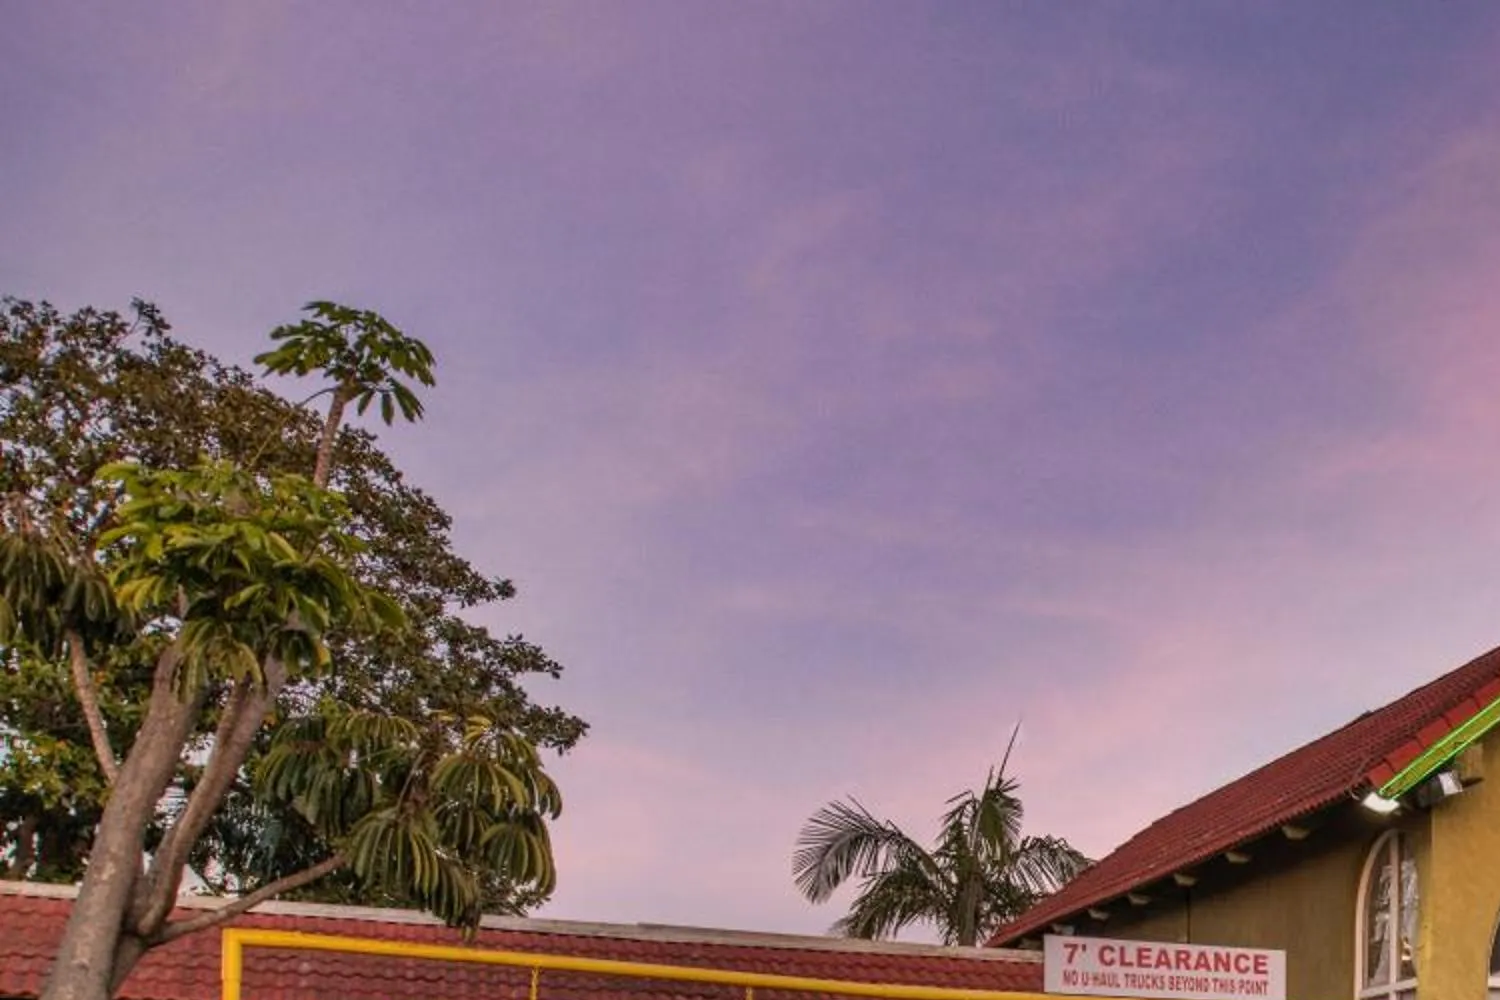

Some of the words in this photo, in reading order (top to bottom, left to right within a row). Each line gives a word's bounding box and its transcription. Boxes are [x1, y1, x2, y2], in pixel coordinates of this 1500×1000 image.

[1063, 943, 1087, 964] 7'
[1098, 944, 1269, 975] CLEARANCE
[1063, 970, 1079, 987] NO
[1124, 973, 1165, 991] TRUCKS
[1168, 975, 1209, 993] BEYOND
[1212, 978, 1236, 994] THIS
[1239, 980, 1269, 995] POINT
